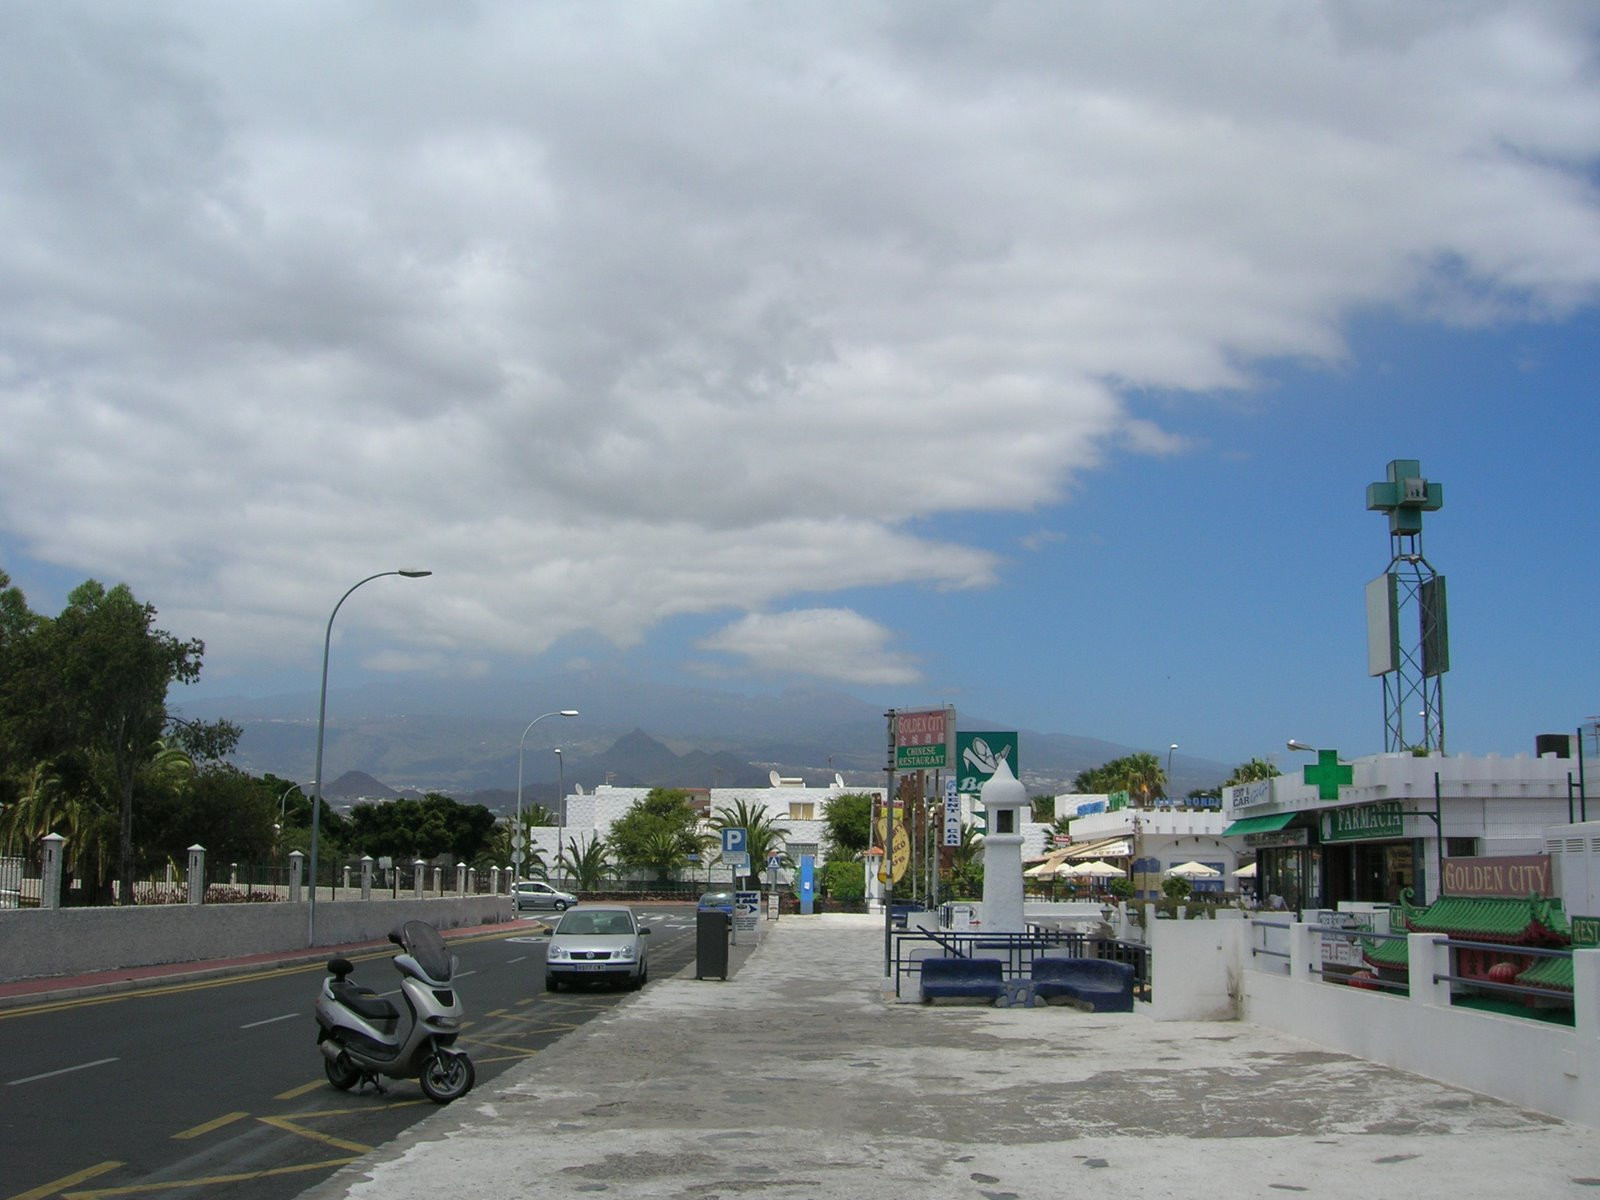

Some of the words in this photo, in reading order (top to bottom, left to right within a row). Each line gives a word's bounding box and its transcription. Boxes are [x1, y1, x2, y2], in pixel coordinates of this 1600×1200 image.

[899, 717, 927, 733] GOLDEN
[928, 714, 945, 731] CITY
[907, 746, 936, 756] CHINESE
[898, 755, 945, 767] RESTAURANT
[947, 792, 959, 813] RENT
[1233, 797, 1250, 808] CAR
[1338, 802, 1402, 832] FARMACIA
[727, 830, 742, 851] P
[946, 828, 958, 845] CAR
[1445, 862, 1504, 892] GOLDEN
[1508, 859, 1549, 893] CITY
